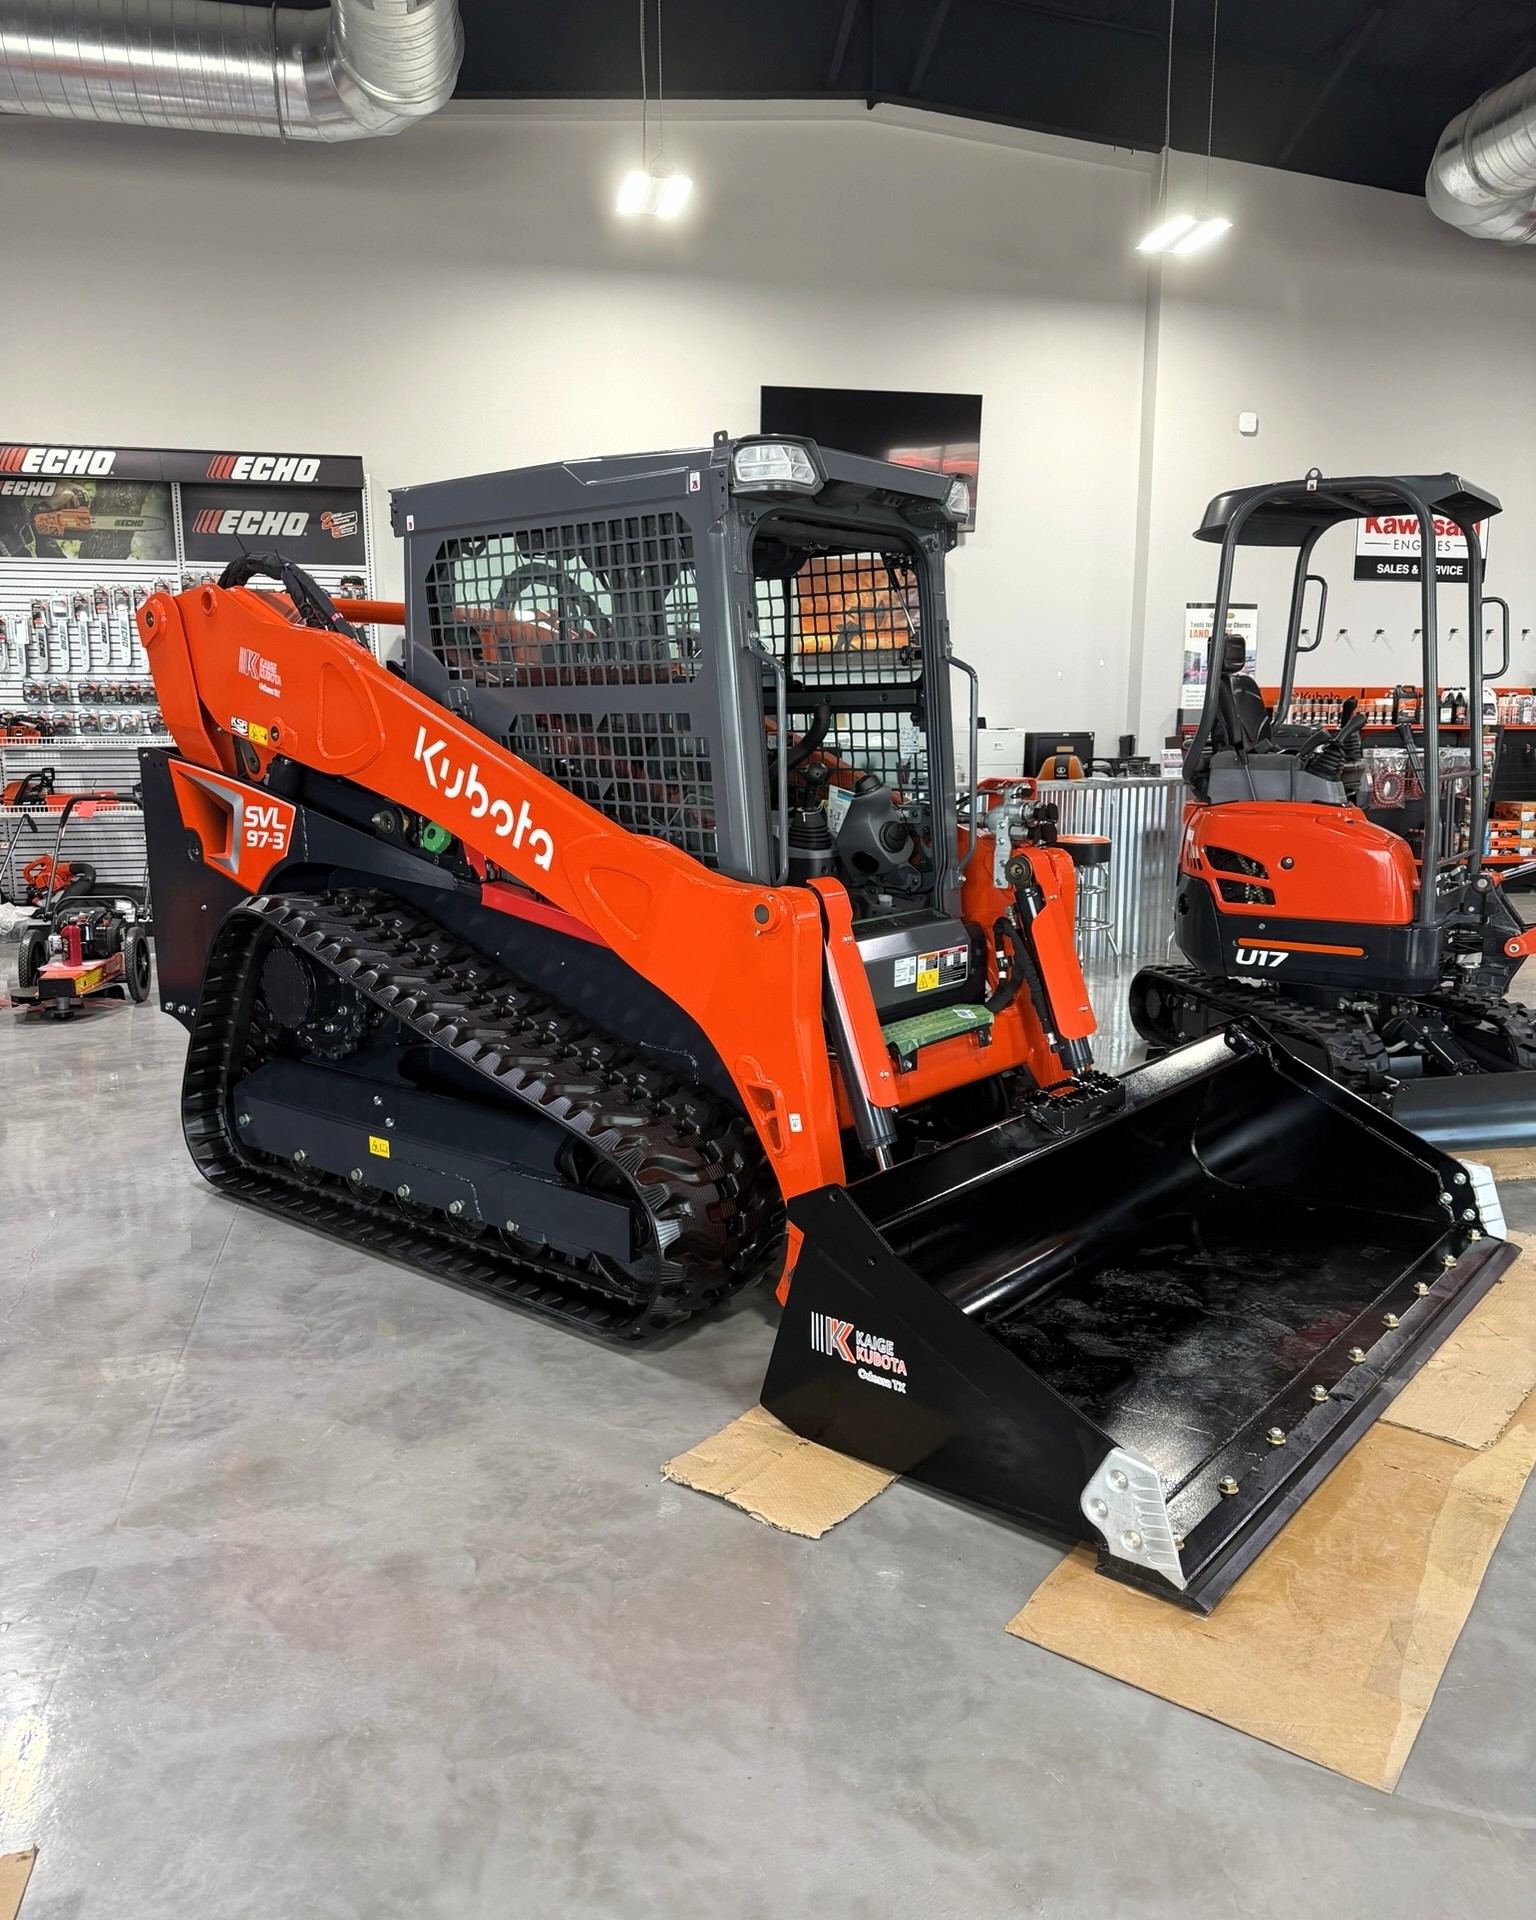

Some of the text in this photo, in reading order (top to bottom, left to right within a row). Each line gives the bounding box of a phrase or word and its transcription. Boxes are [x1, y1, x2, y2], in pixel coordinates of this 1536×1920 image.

[21, 448, 117, 475] ECHO
[230, 455, 321, 483] ECHO
[1, 480, 57, 497] ECHO
[120, 519, 144, 528] ECHO
[217, 509, 310, 537] ECHO
[1365, 516, 1481, 538] Kawsa
[1393, 539, 1451, 552] ENGES
[1376, 563, 1464, 576] SALES & RVICE
[413, 725, 554, 872] Kubota
[243, 805, 287, 830] SVL
[246, 829, 285, 850] 97-3
[1235, 948, 1289, 967] U17
[856, 1330, 894, 1357] KAIGE
[856, 1345, 908, 1377] KUBOTA
